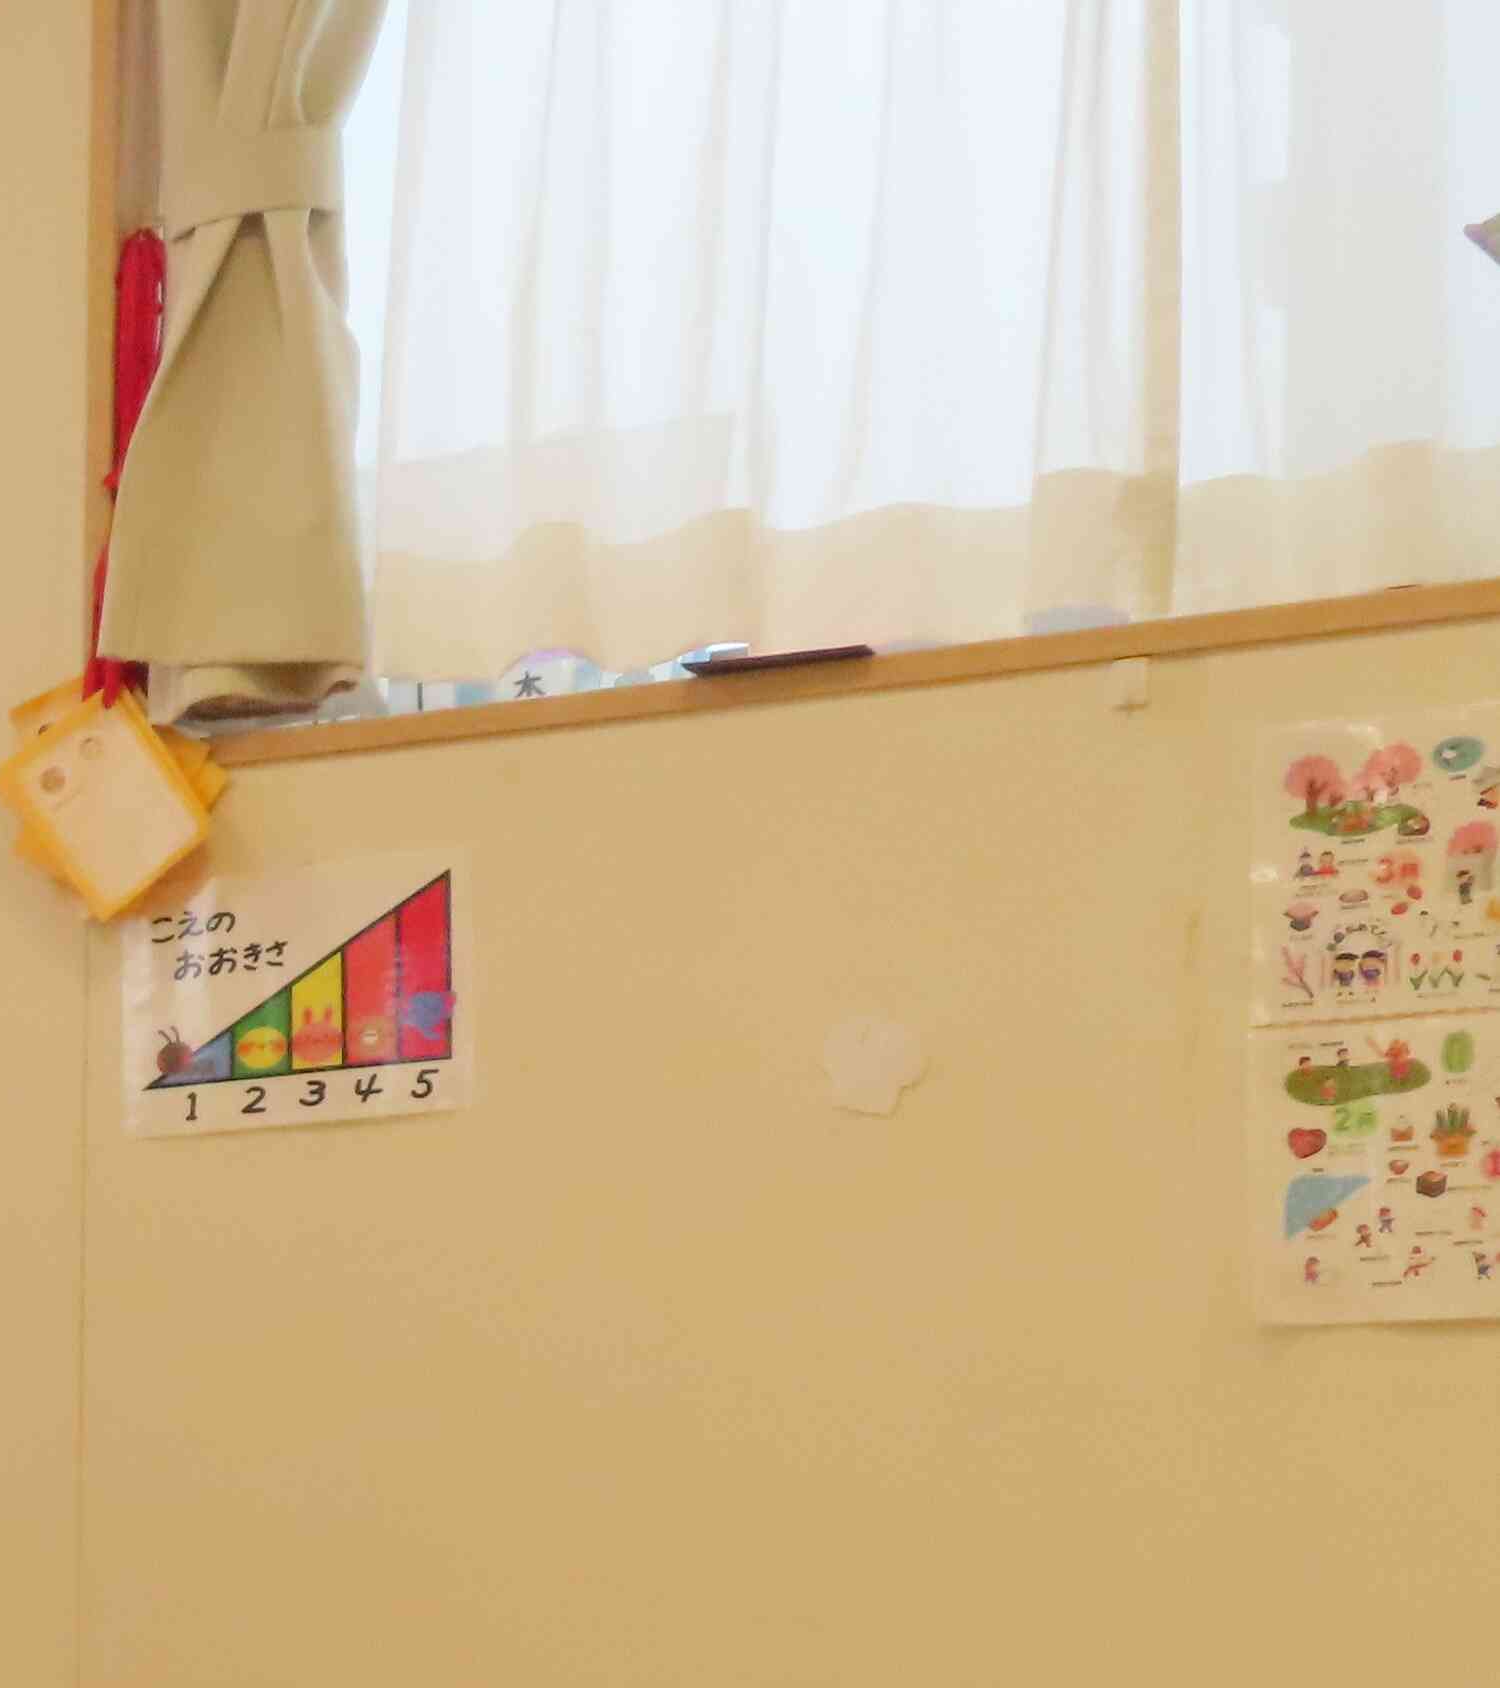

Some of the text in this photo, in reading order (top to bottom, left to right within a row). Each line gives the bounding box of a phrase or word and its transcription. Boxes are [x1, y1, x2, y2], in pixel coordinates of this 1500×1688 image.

[513, 670, 546, 697] 木
[151, 911, 236, 943] こえの
[173, 940, 288, 980] おおきさ
[185, 1069, 440, 1121] 1 2 3 4 5
